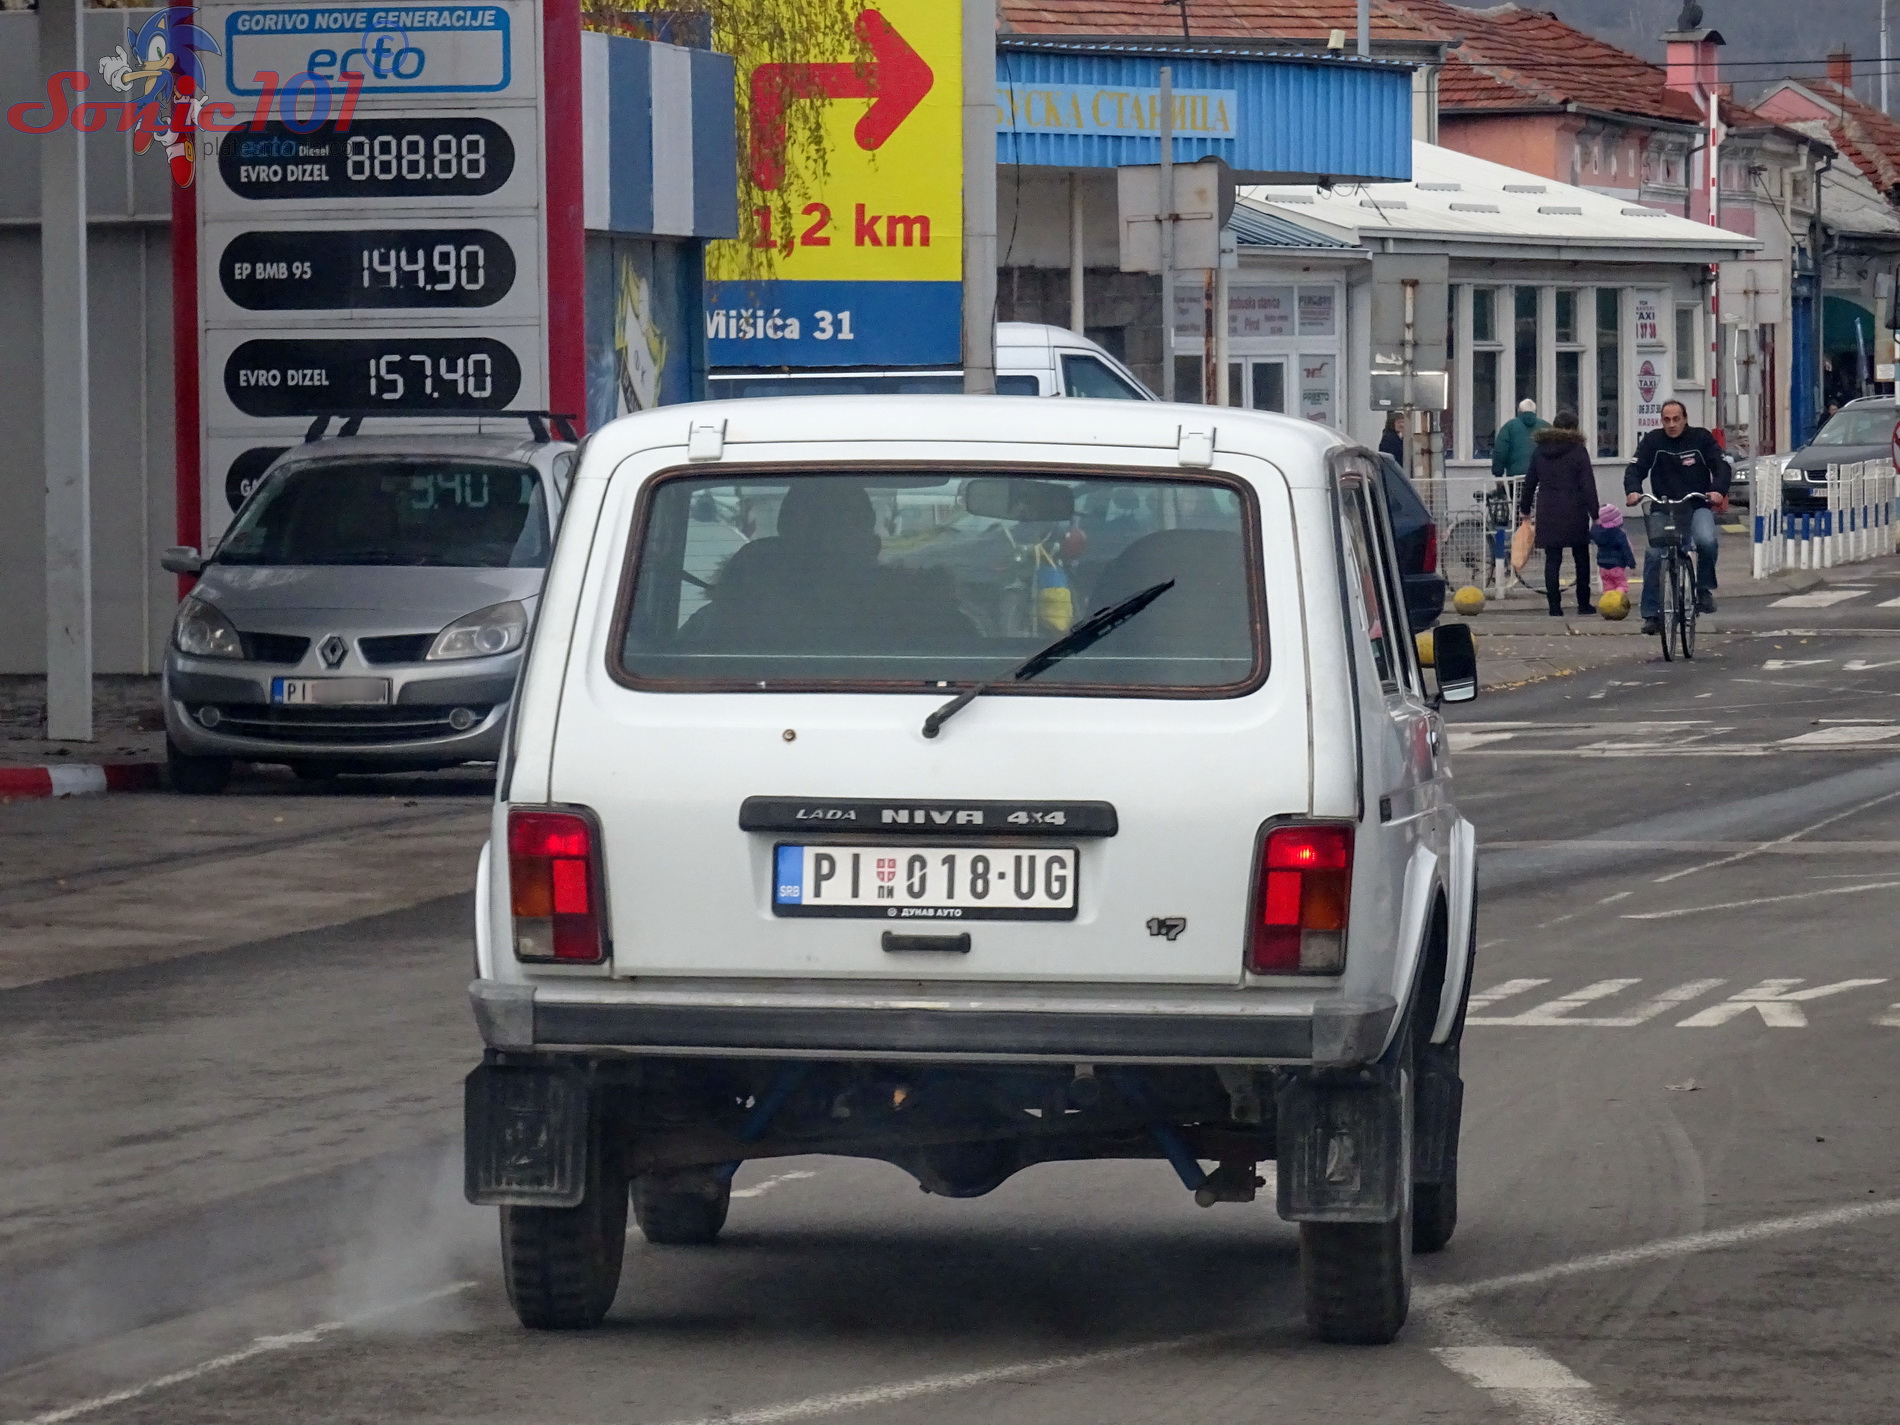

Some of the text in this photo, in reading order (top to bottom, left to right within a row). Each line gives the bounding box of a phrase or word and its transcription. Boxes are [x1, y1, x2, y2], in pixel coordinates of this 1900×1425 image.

[237, 10, 496, 31] GORIVO NOVE GENERACIJE
[306, 38, 426, 80] ecto
[239, 134, 486, 182] EVRO DIZEL 888.88
[299, 144, 329, 157] Diesel
[752, 203, 931, 259] 1,2 km
[234, 244, 485, 291] EP BMB 95 144.90
[812, 310, 854, 340] 31
[239, 353, 492, 400] EVRO DIZEL 157.40
[287, 682, 306, 702] PI
[796, 808, 857, 820] LADA
[880, 809, 985, 825] NIVA
[813, 852, 861, 899] PI
[779, 885, 800, 897] SRB
[901, 908, 962, 918] ДУНАВ АУТО
[1146, 917, 1187, 941] 1.7
